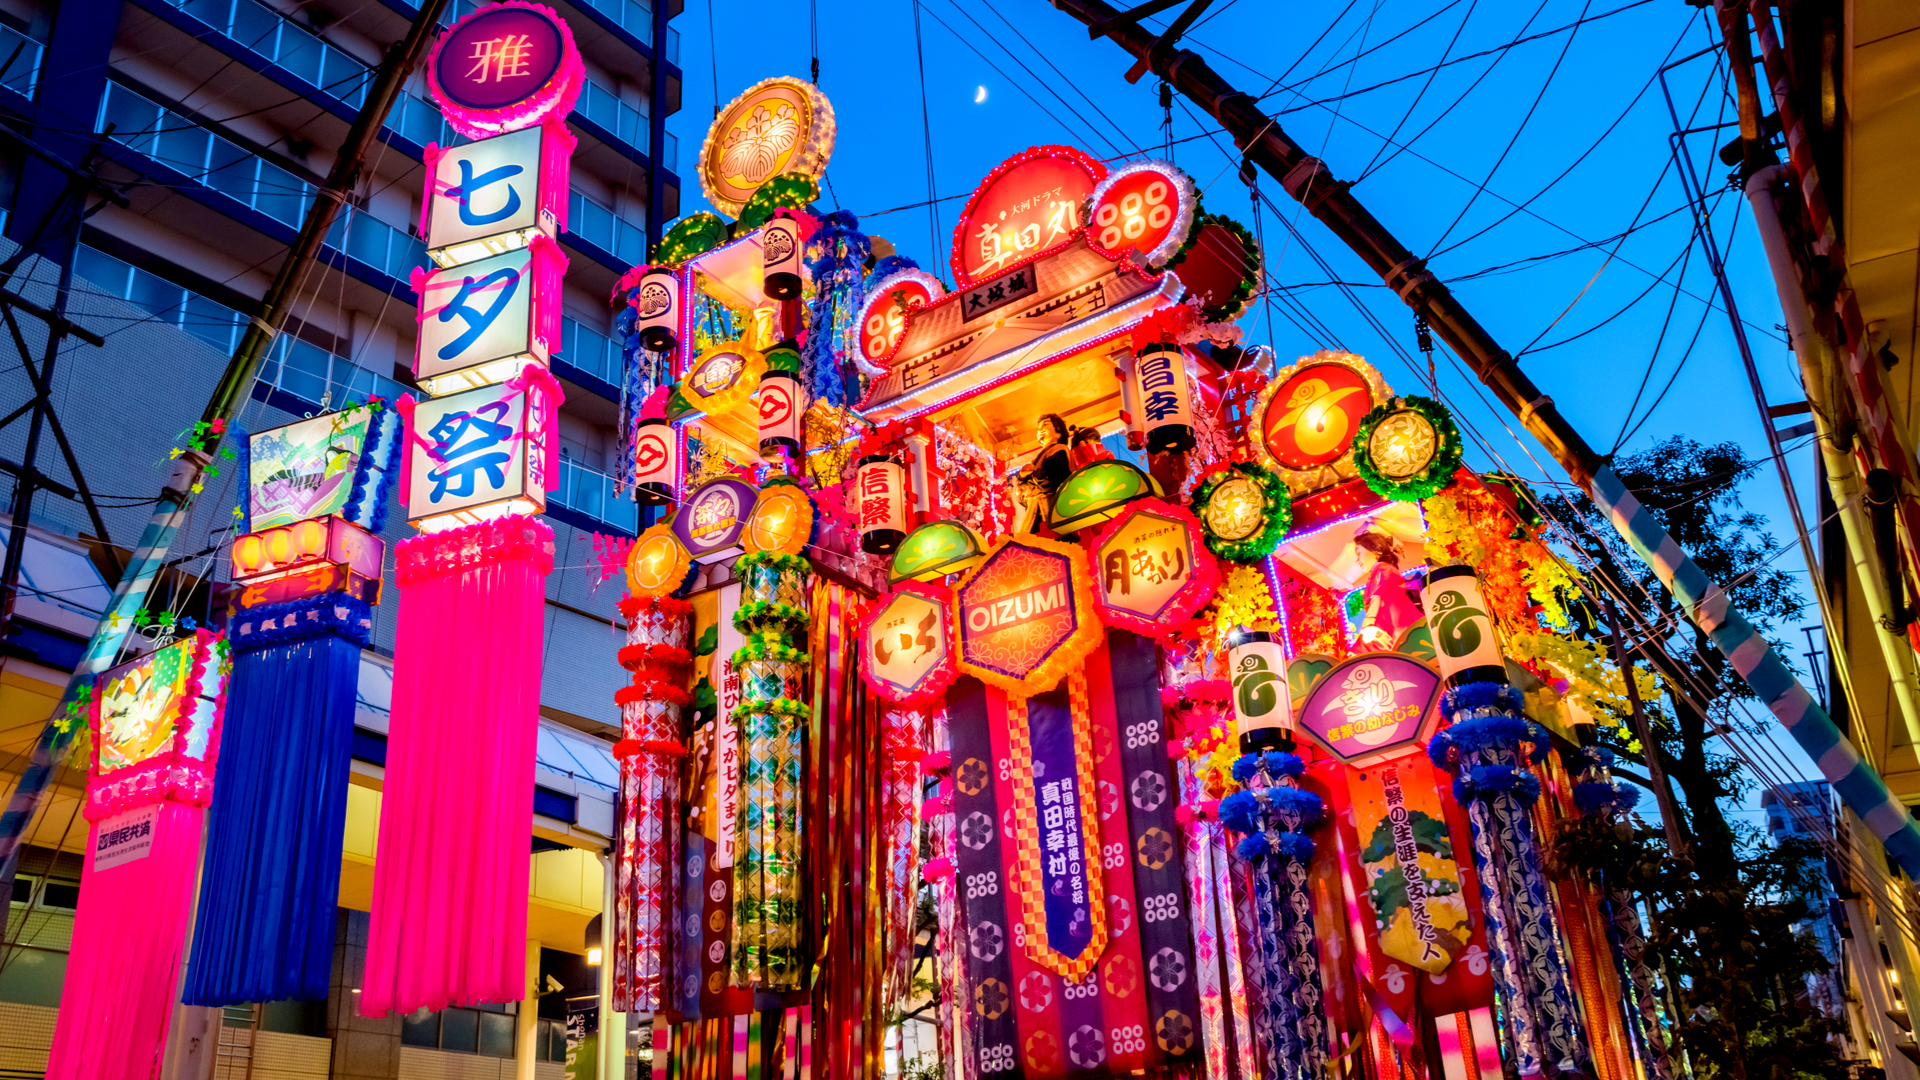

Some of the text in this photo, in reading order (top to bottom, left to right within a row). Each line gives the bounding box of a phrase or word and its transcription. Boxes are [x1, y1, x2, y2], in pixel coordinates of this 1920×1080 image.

[464, 34, 534, 84] 雅
[1010, 186, 1062, 217] 大河ドラマ
[968, 199, 1079, 275] 真田丸
[967, 272, 1029, 313] 大坂城
[427, 159, 524, 504] 七夕祭
[1140, 357, 1180, 421] 昌幸
[860, 467, 892, 527] 信繁
[1133, 524, 1178, 544] 酒菜の隠れ家
[1105, 547, 1185, 596] 月あかり
[968, 582, 1066, 632] OIZUMI
[1340, 677, 1395, 716] きり
[1326, 704, 1421, 743] 信繁の幼なじみ
[108, 820, 151, 848] 県民共済
[1040, 780, 1067, 877] 真田幸村
[1060, 777, 1084, 906] 戦国時代最後の名将
[1381, 767, 1442, 963] 信繁の生涯を支えた人
